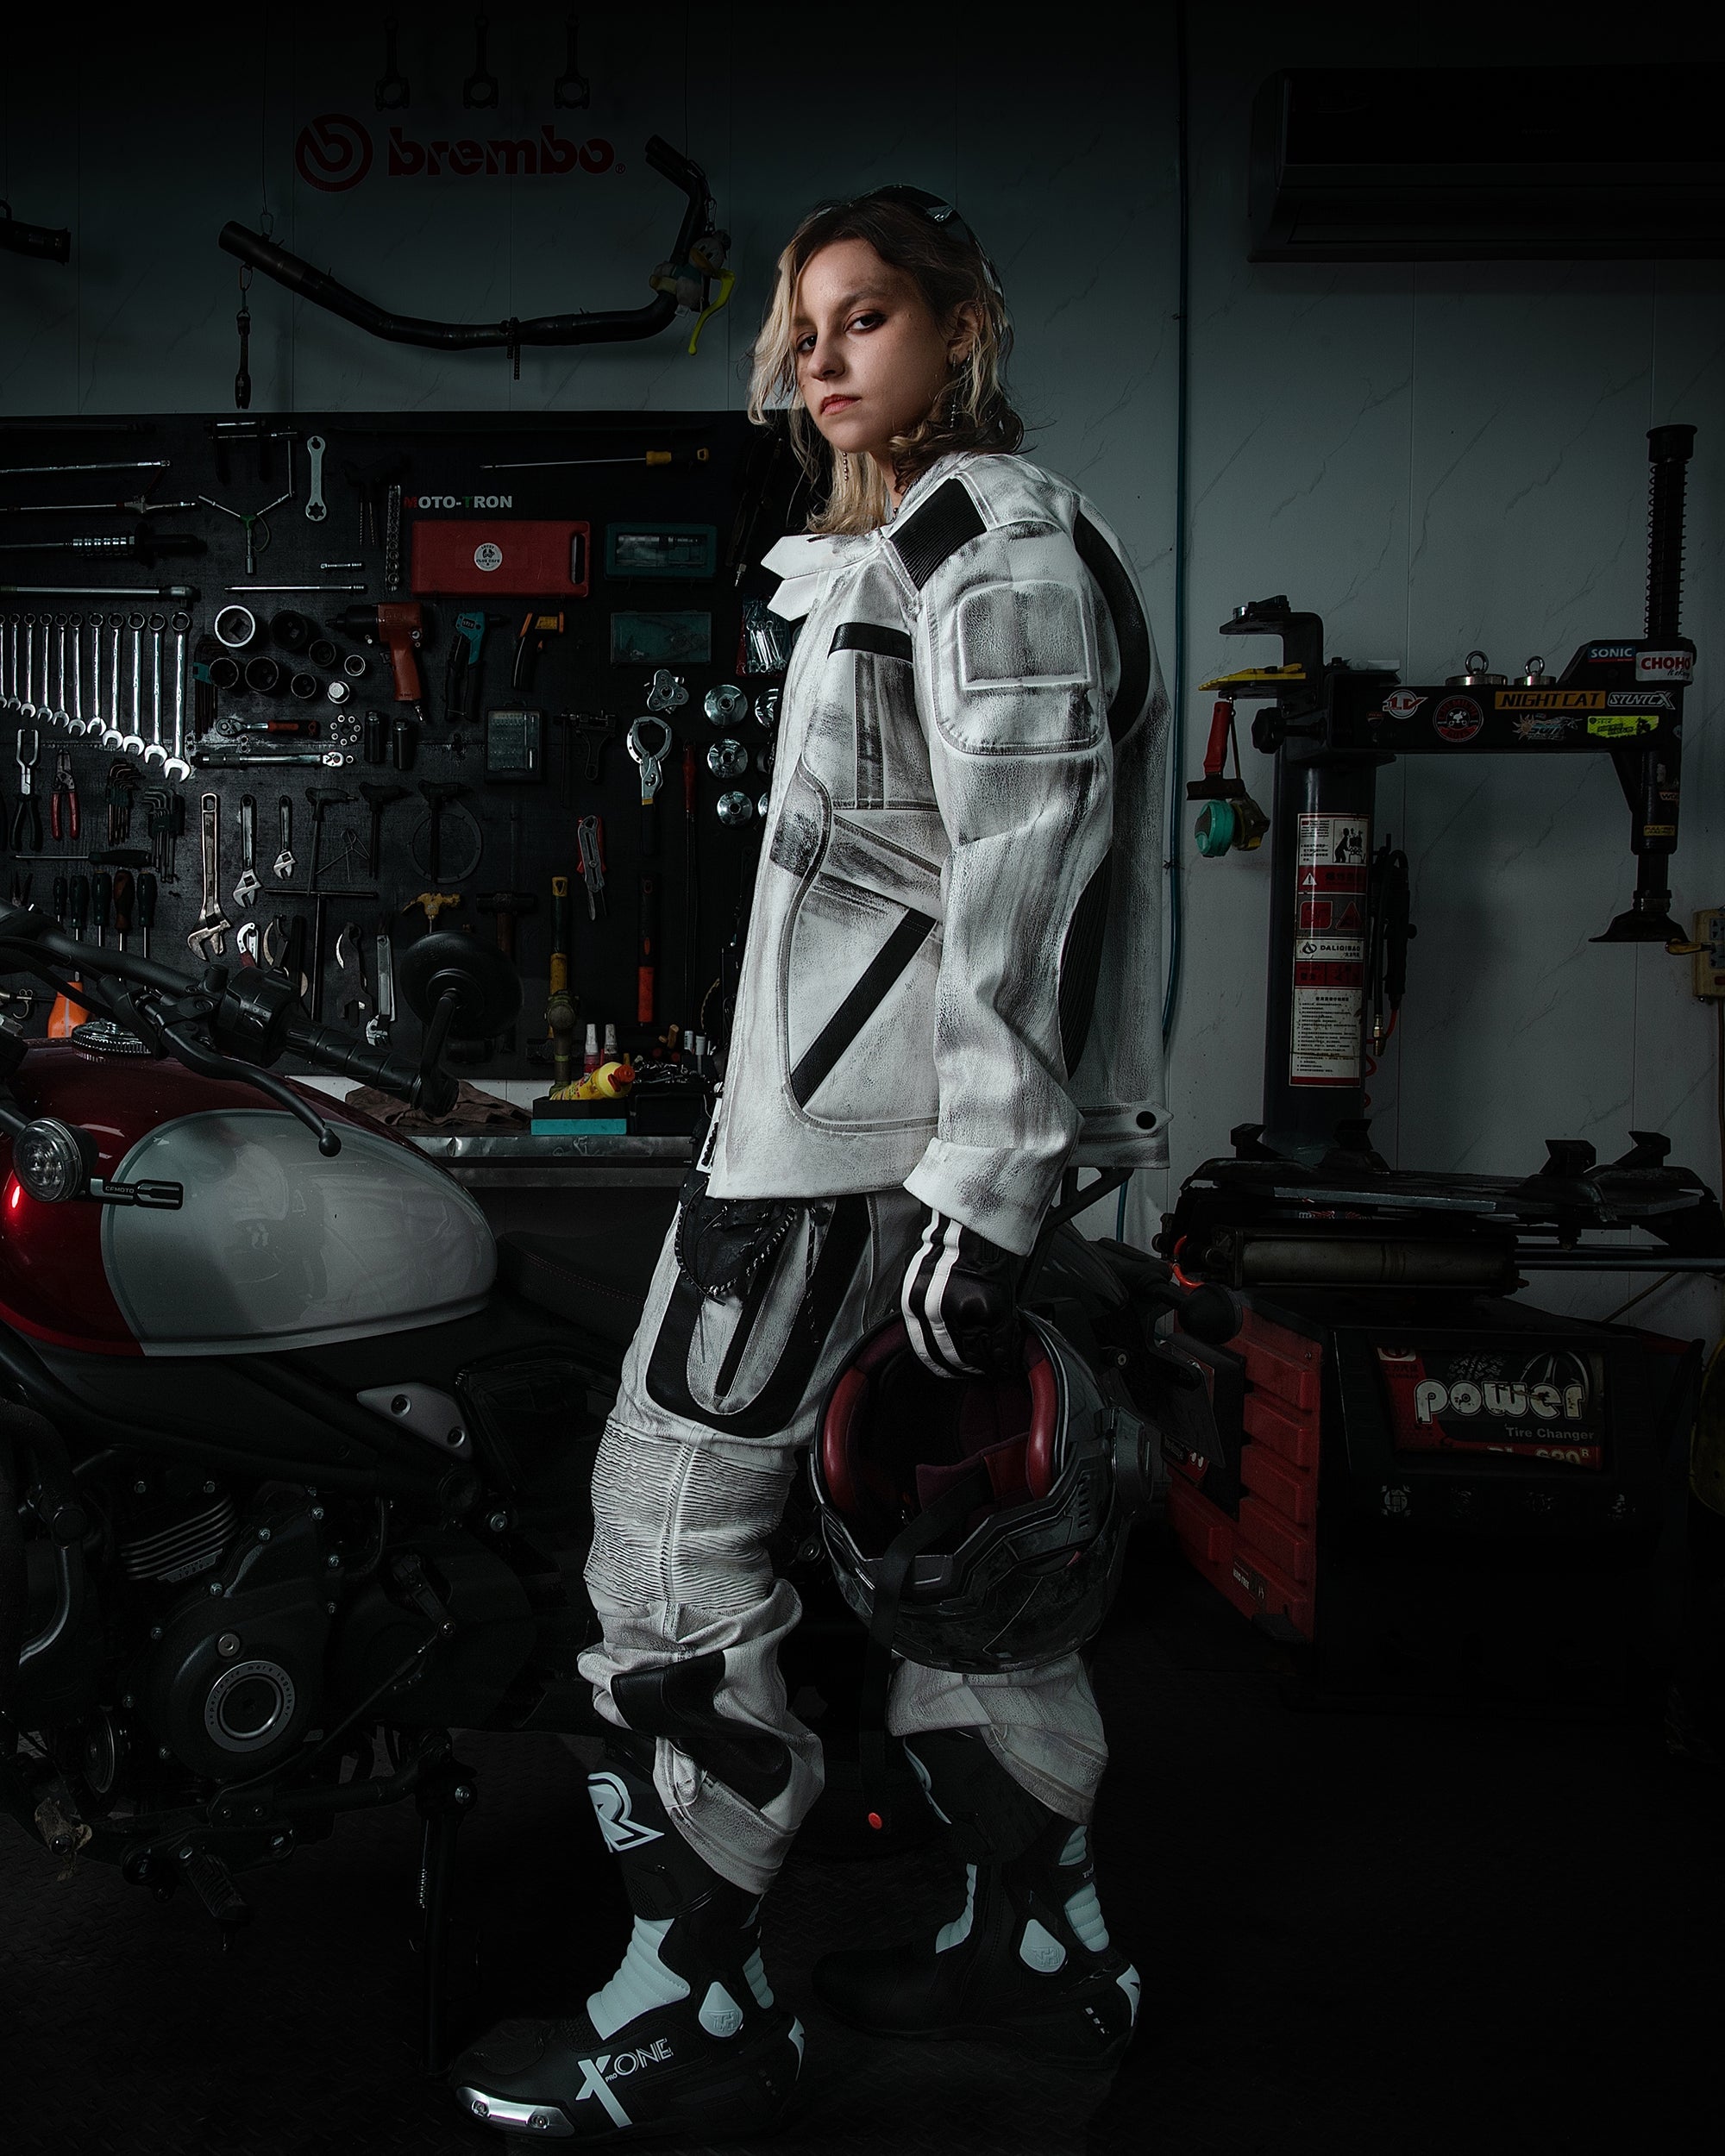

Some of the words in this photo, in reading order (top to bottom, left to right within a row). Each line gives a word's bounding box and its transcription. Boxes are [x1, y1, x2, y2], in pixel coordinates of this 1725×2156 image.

[388, 124, 615, 176] brembo
[402, 495, 513, 510] MOTO-TRON
[1590, 647, 1634, 659] SONIC
[1640, 656, 1690, 671] CHOHO
[1502, 693, 1559, 707] NIGHT
[1562, 693, 1602, 707] CAT
[104, 1185, 135, 1194] CFMOTO
[1414, 1379, 1584, 1425] power
[1505, 1426, 1534, 1438] Tire
[1536, 1427, 1595, 1442] Changer
[605, 2071, 618, 2083] PRO
